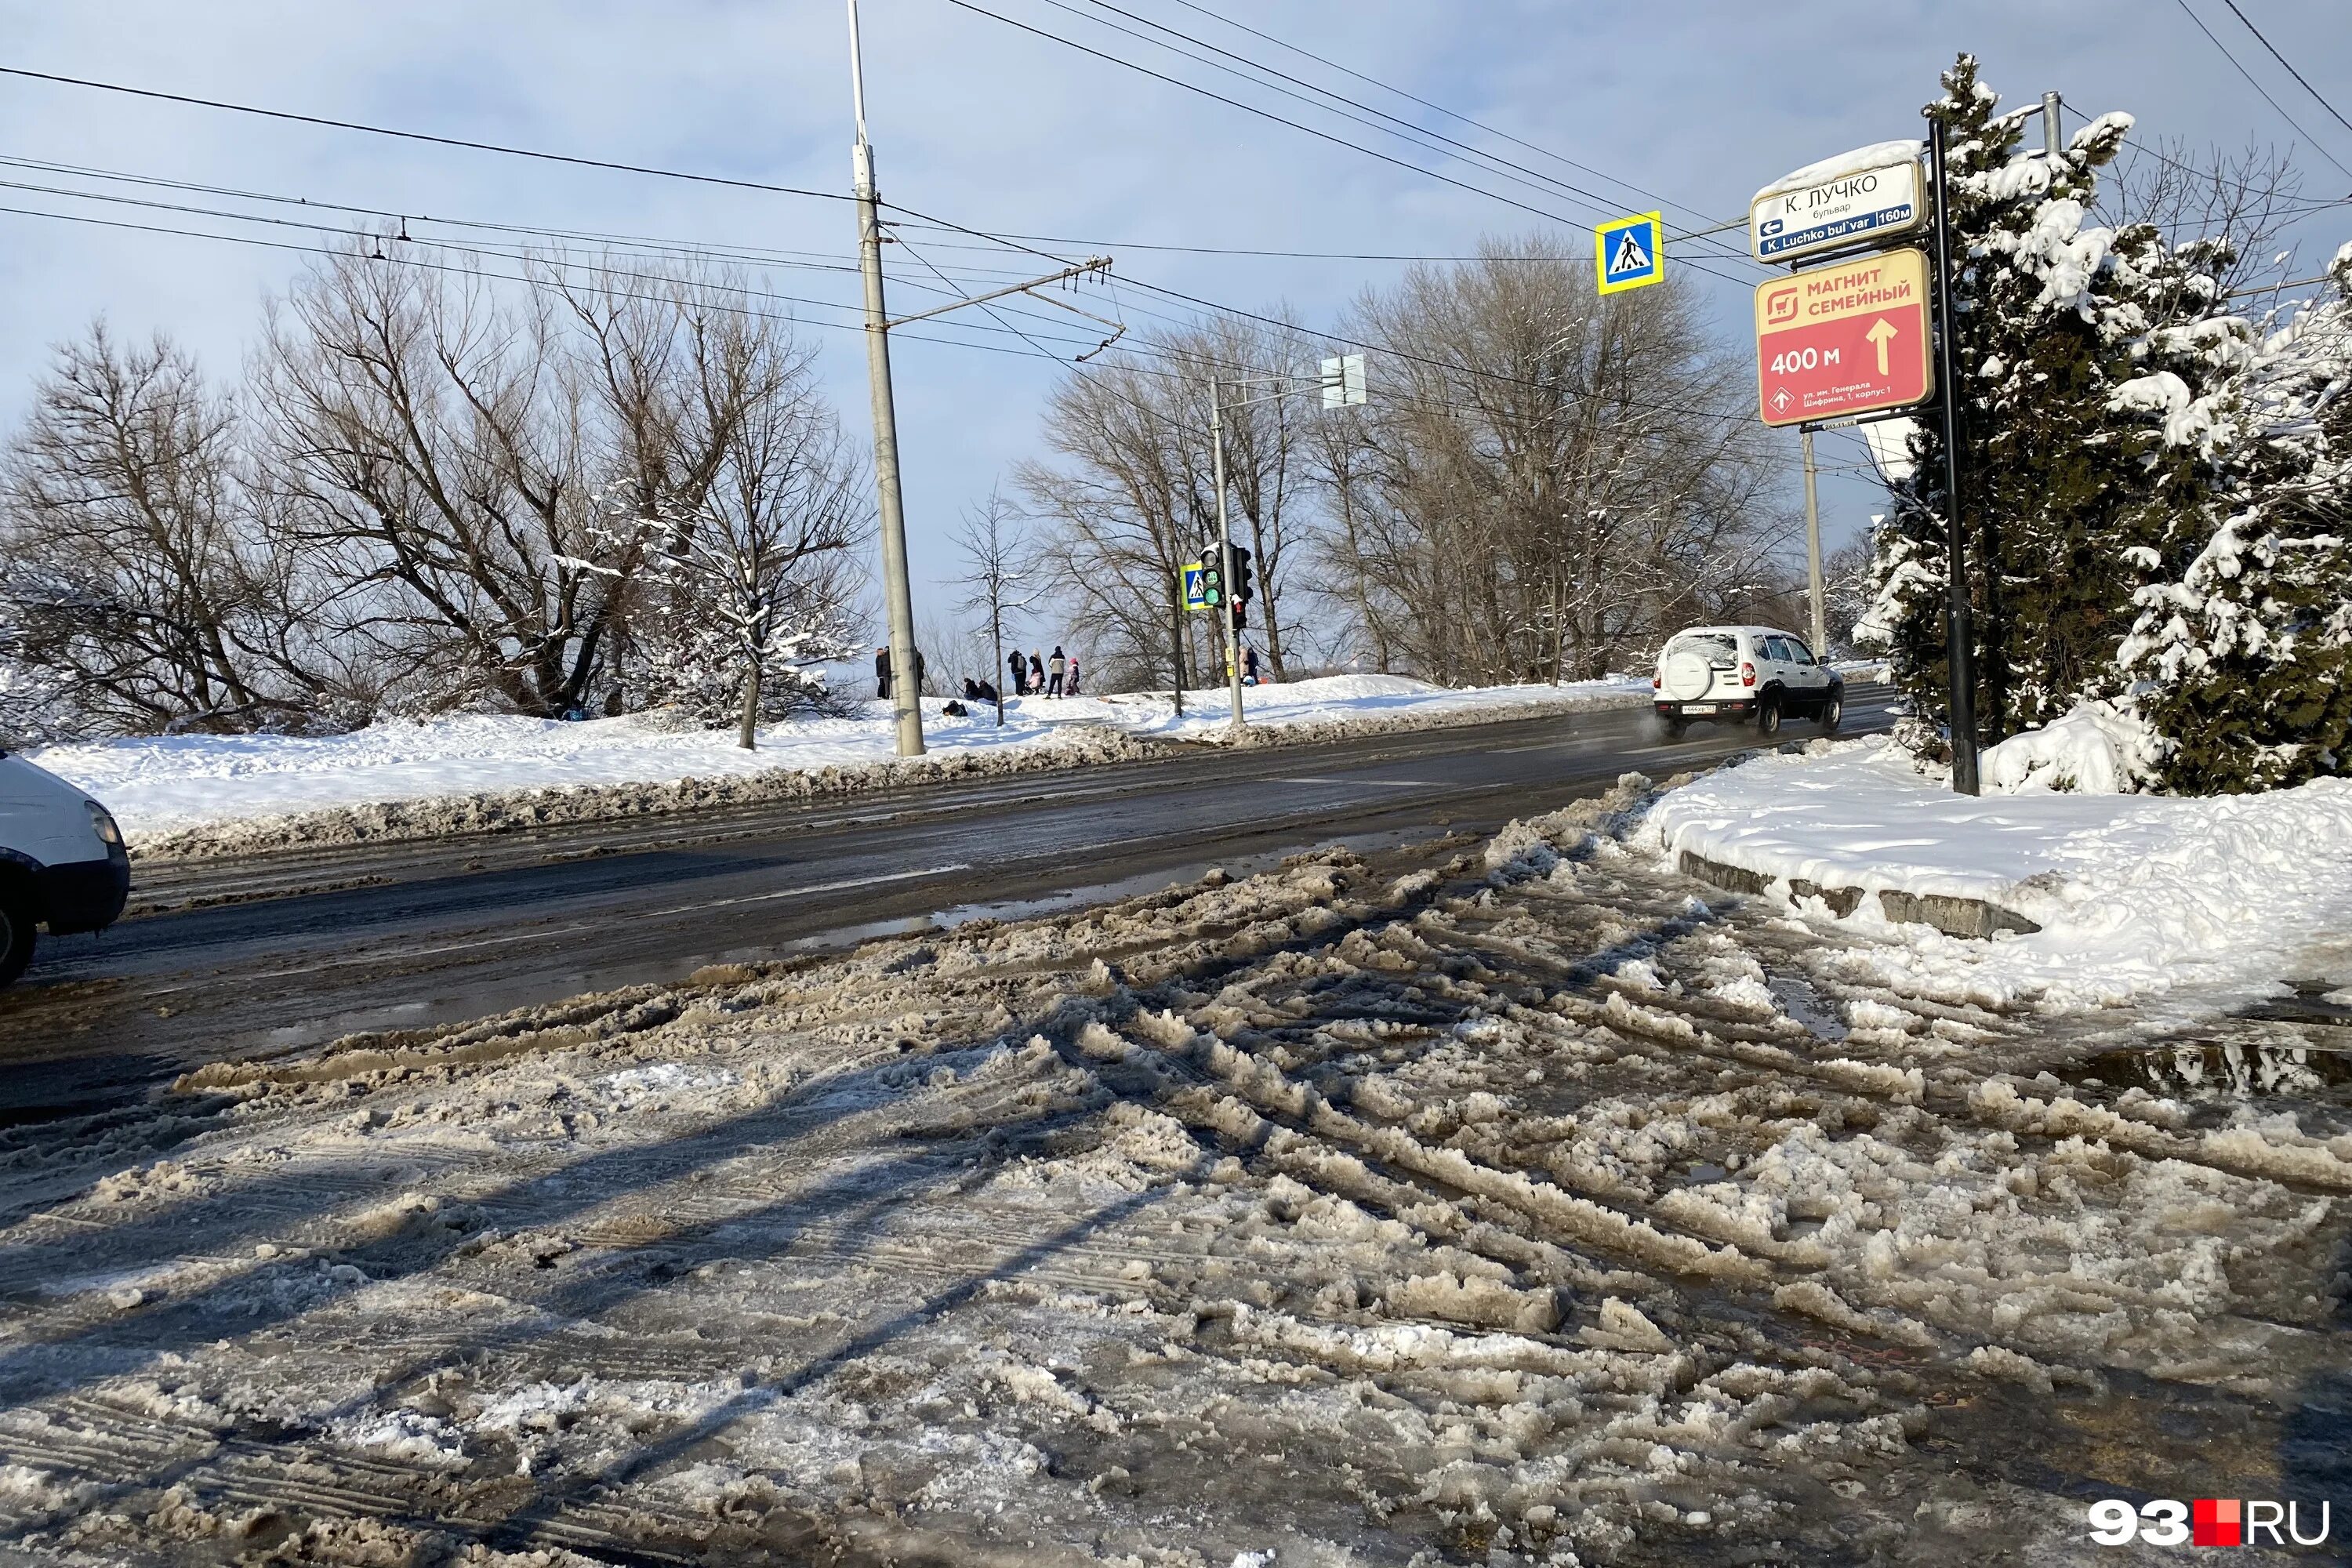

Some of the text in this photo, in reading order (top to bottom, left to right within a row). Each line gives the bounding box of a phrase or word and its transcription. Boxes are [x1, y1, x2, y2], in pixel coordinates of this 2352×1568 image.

[1786, 176, 1878, 213] К. ЛУЧКО
[1813, 204, 1851, 220] бульвар
[1767, 241, 1780, 252] K.
[1783, 230, 1825, 248] Luchko
[1807, 268, 1882, 297] МАГНИТ
[1808, 280, 1911, 316] СЕМЕЙНЫЙ
[1770, 347, 1818, 376] 400
[1804, 395, 1846, 408] Шифрина,
[1855, 388, 1886, 399] корпус
[1831, 382, 1871, 394] Генерала
